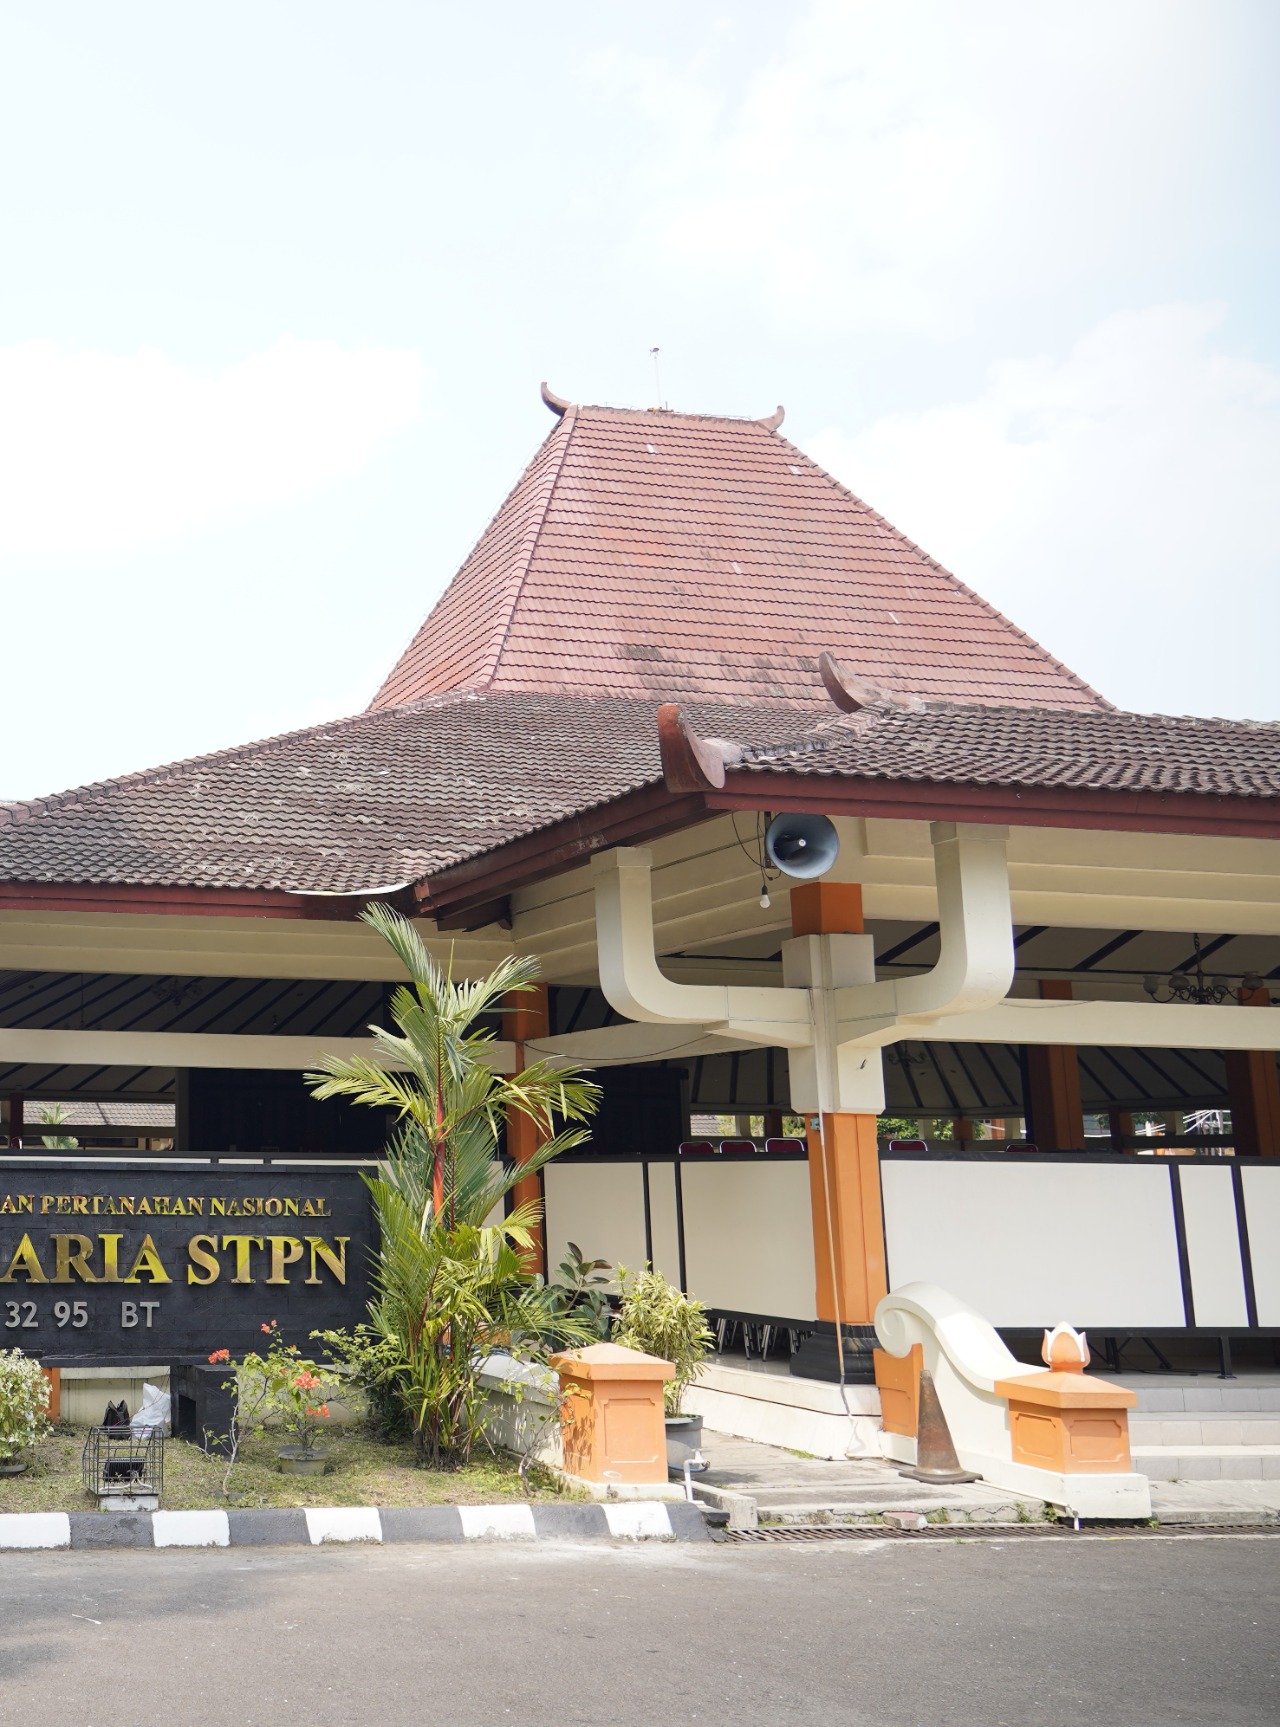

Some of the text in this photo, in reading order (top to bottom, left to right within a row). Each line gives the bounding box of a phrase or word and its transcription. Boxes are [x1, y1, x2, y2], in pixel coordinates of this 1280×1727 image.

[39, 1195, 205, 1217] PERTANAHAN
[209, 1197, 332, 1218] NASIONAL
[186, 1234, 351, 1286] STPN
[4, 1301, 39, 1328] 32
[53, 1301, 89, 1328] 95
[121, 1301, 161, 1328] BT
